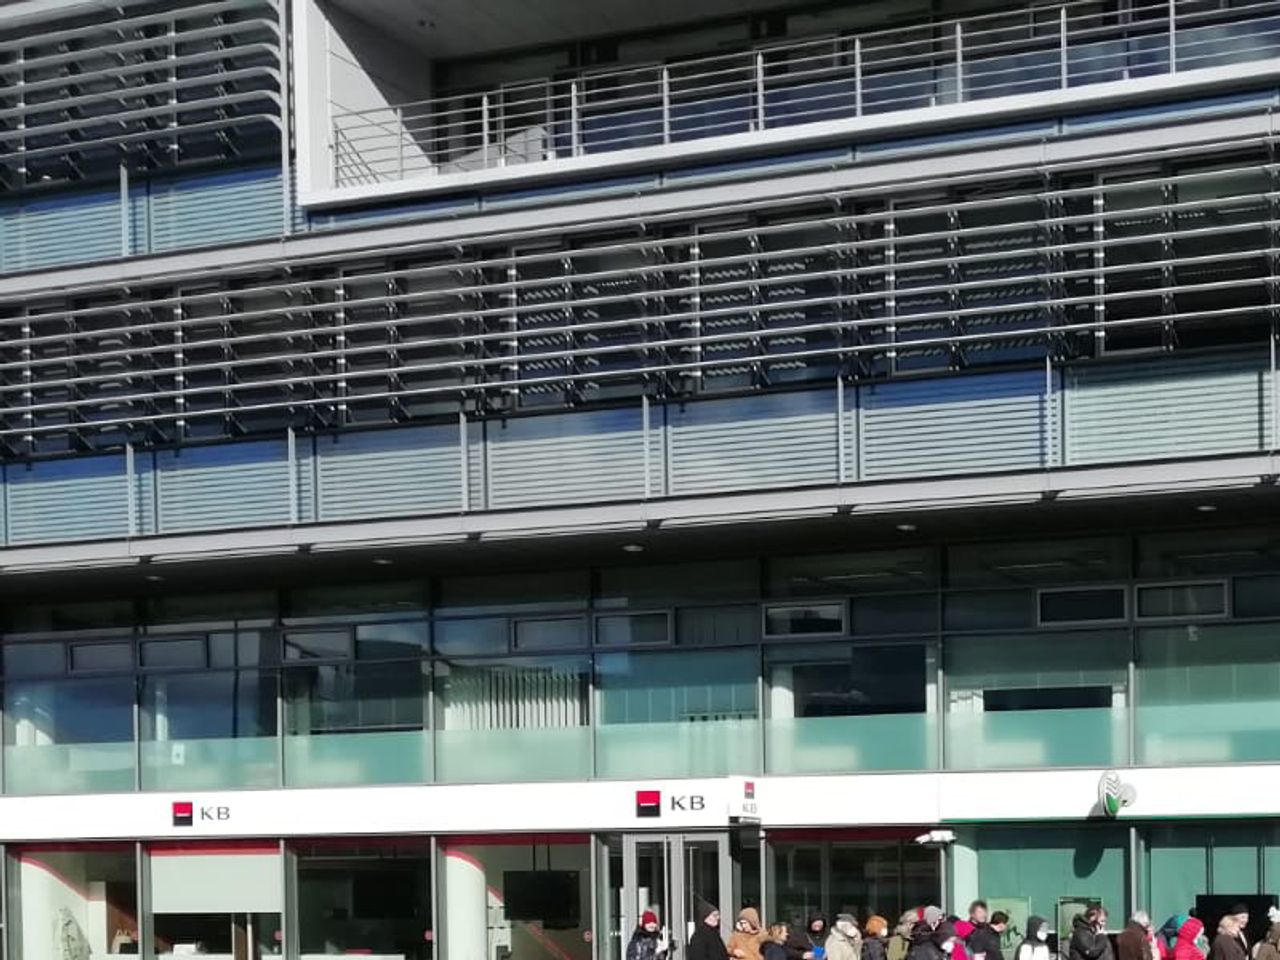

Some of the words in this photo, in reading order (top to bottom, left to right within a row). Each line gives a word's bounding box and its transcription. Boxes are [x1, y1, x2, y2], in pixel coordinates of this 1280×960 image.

[671, 795, 705, 811] KB
[742, 802, 757, 814] KB
[201, 806, 230, 821] KB
